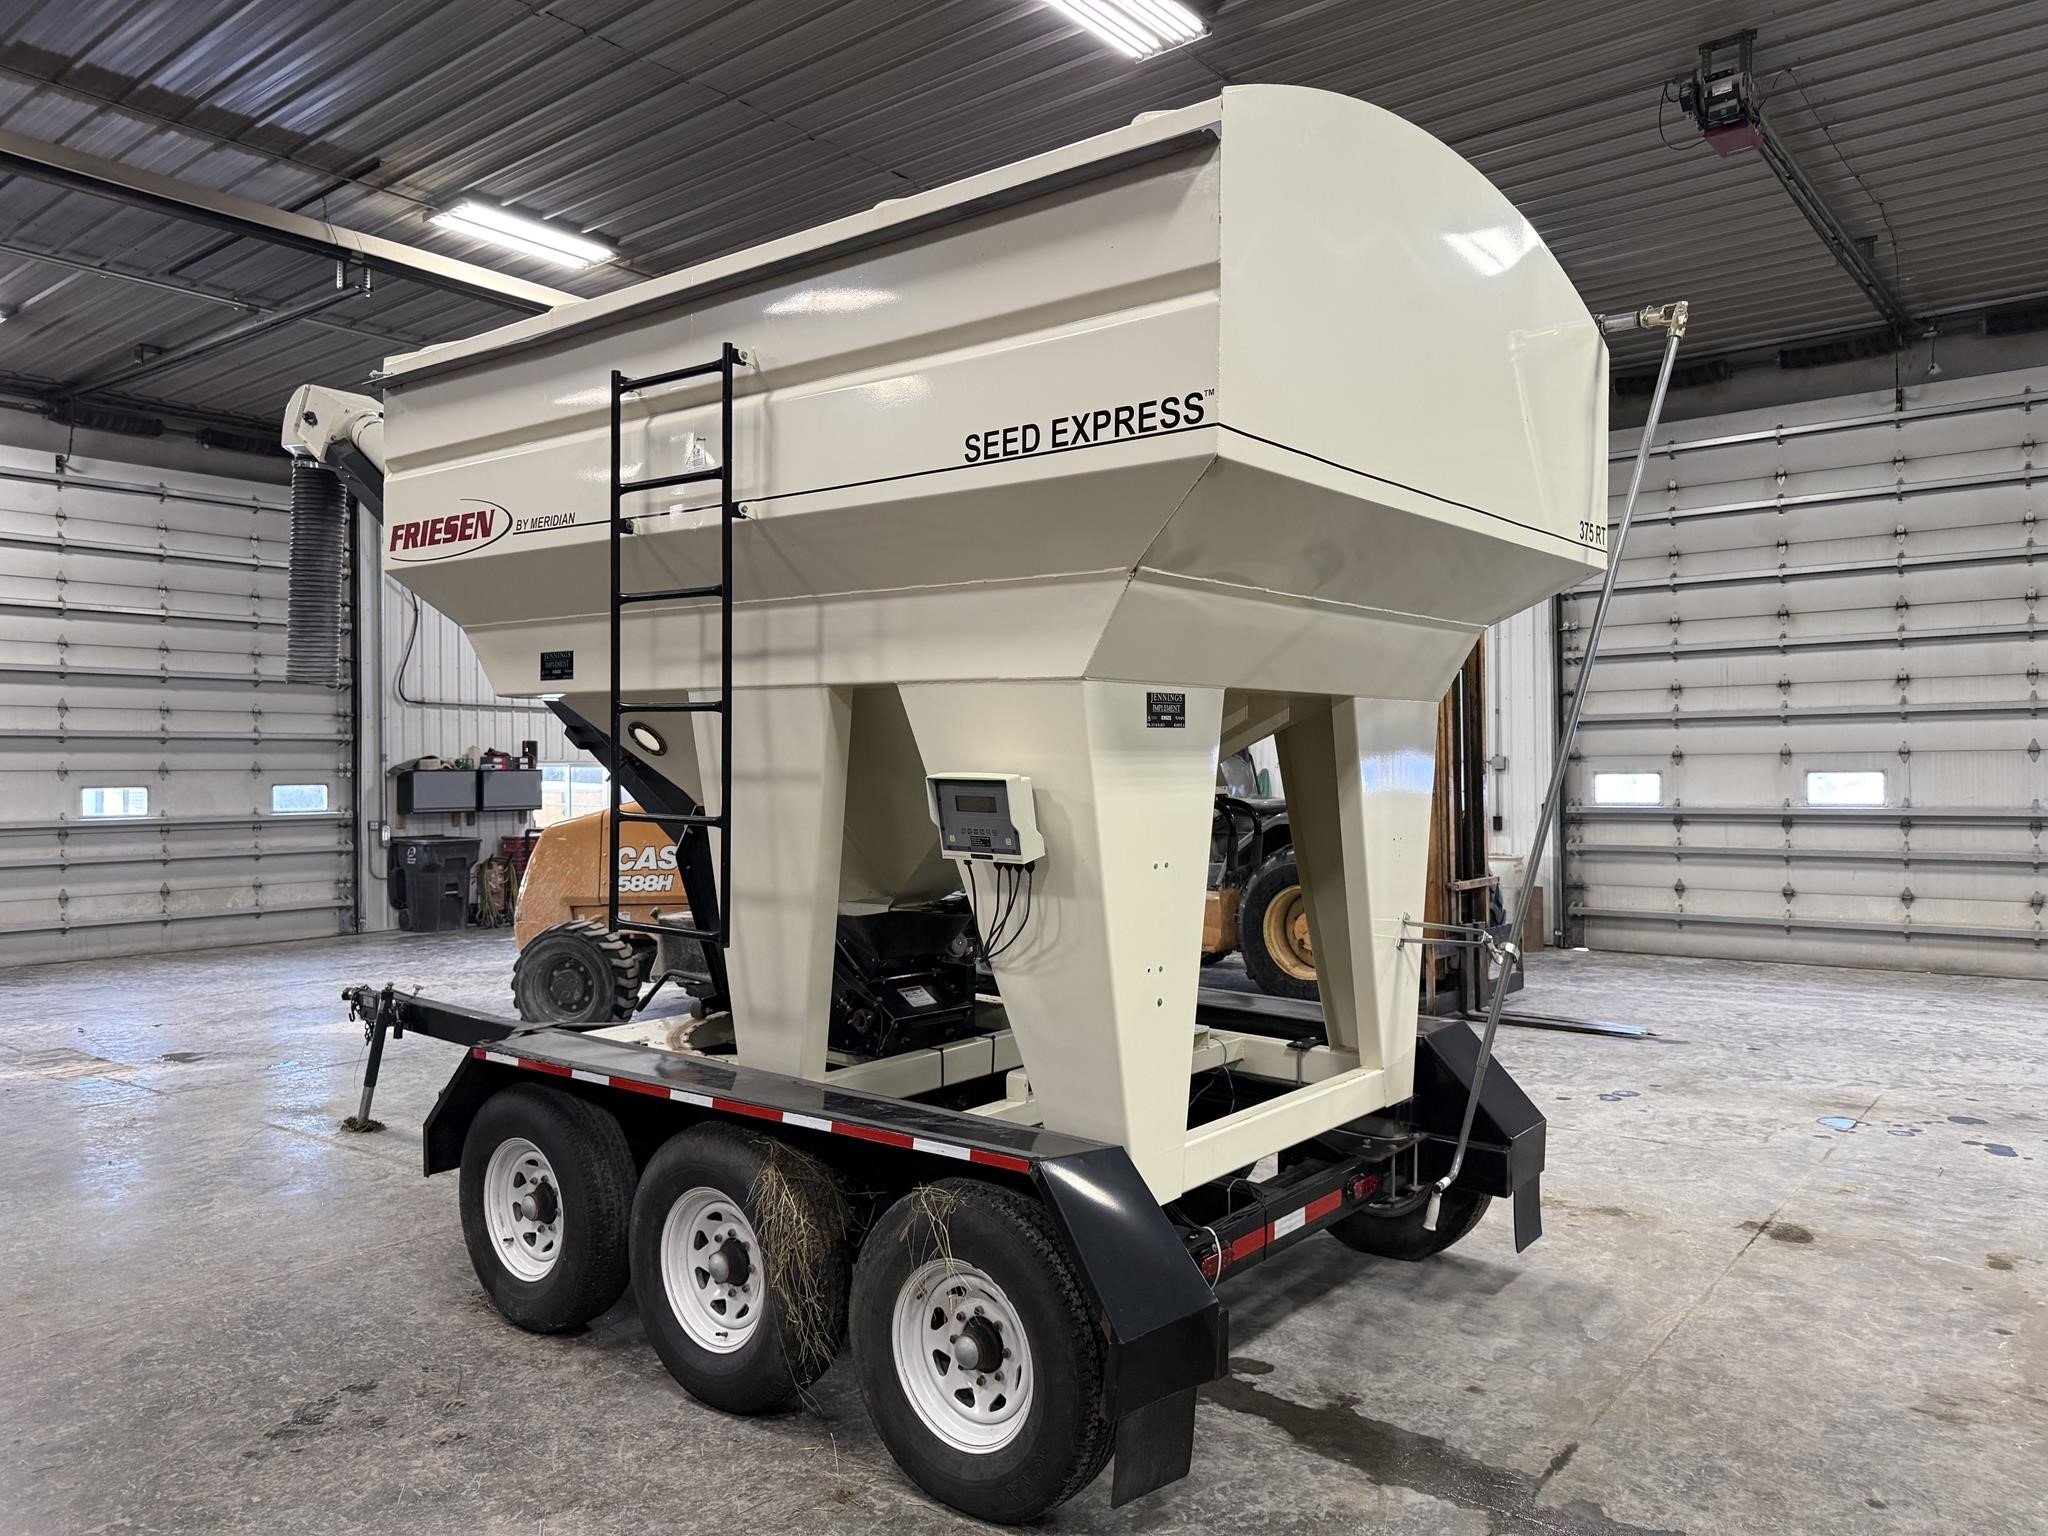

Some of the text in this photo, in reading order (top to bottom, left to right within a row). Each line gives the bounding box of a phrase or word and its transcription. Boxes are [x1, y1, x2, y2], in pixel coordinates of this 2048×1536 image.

[964, 423, 1041, 463] SEED
[1051, 392, 1205, 449] EXPRESS
[389, 508, 495, 552] FRIESEN
[516, 512, 576, 531] BY MERIDIAN
[1579, 520, 1606, 546] 375 RT
[1150, 693, 1183, 703] JENNINGS
[1152, 704, 1180, 713] IMPLEMENT
[618, 845, 679, 871] CAS
[618, 874, 674, 893] 588H
